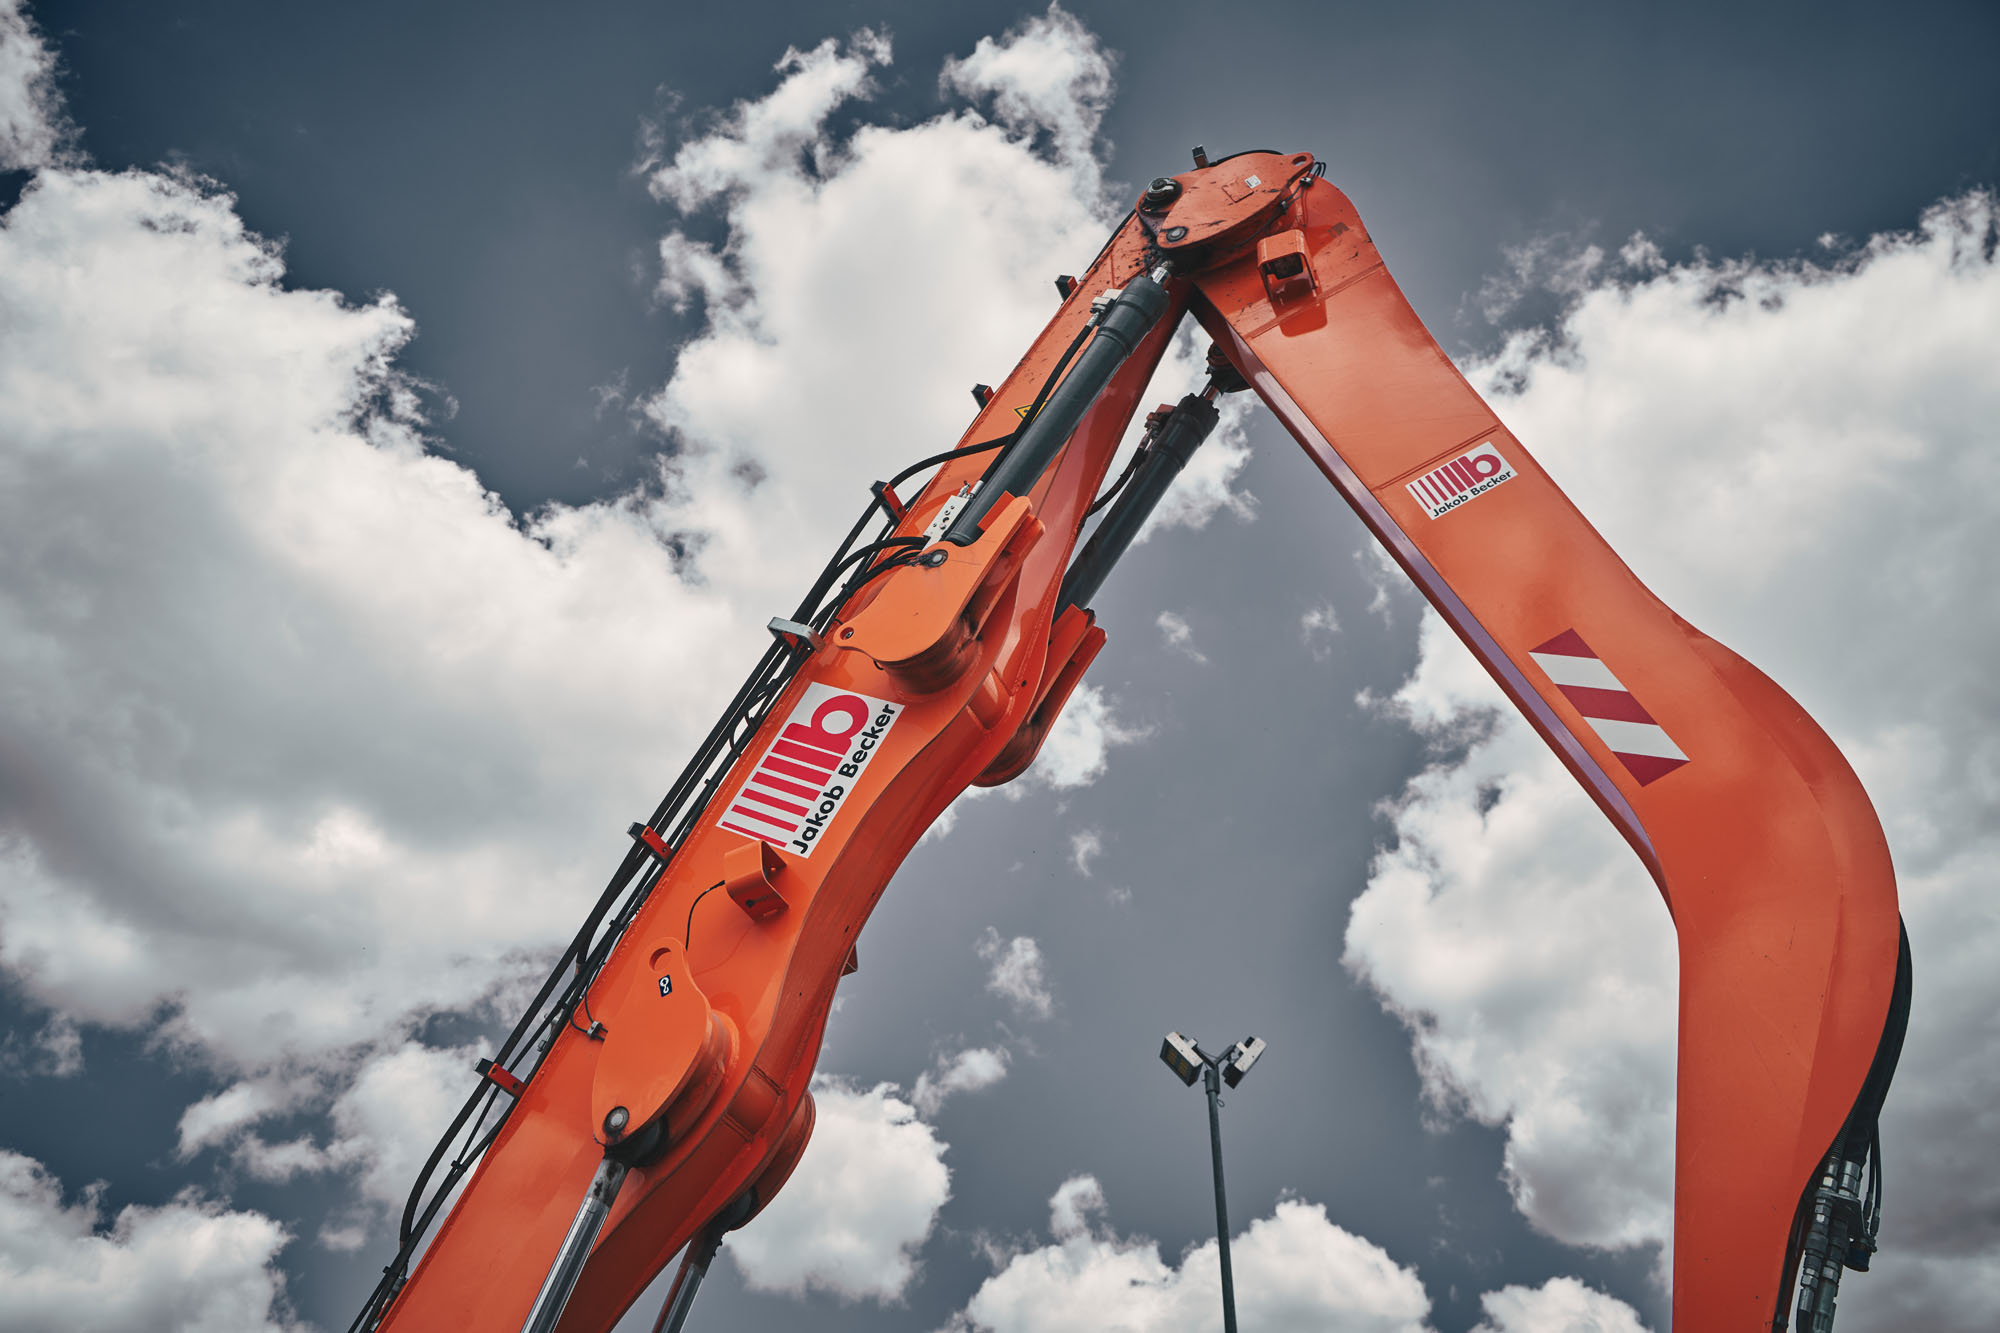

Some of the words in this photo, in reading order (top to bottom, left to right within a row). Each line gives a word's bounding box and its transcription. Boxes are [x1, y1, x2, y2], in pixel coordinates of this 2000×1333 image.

[1433, 494, 1469, 517] Jakob
[1470, 470, 1512, 496] Becker
[792, 785, 845, 854] Jakob
[838, 704, 896, 778] Becker
